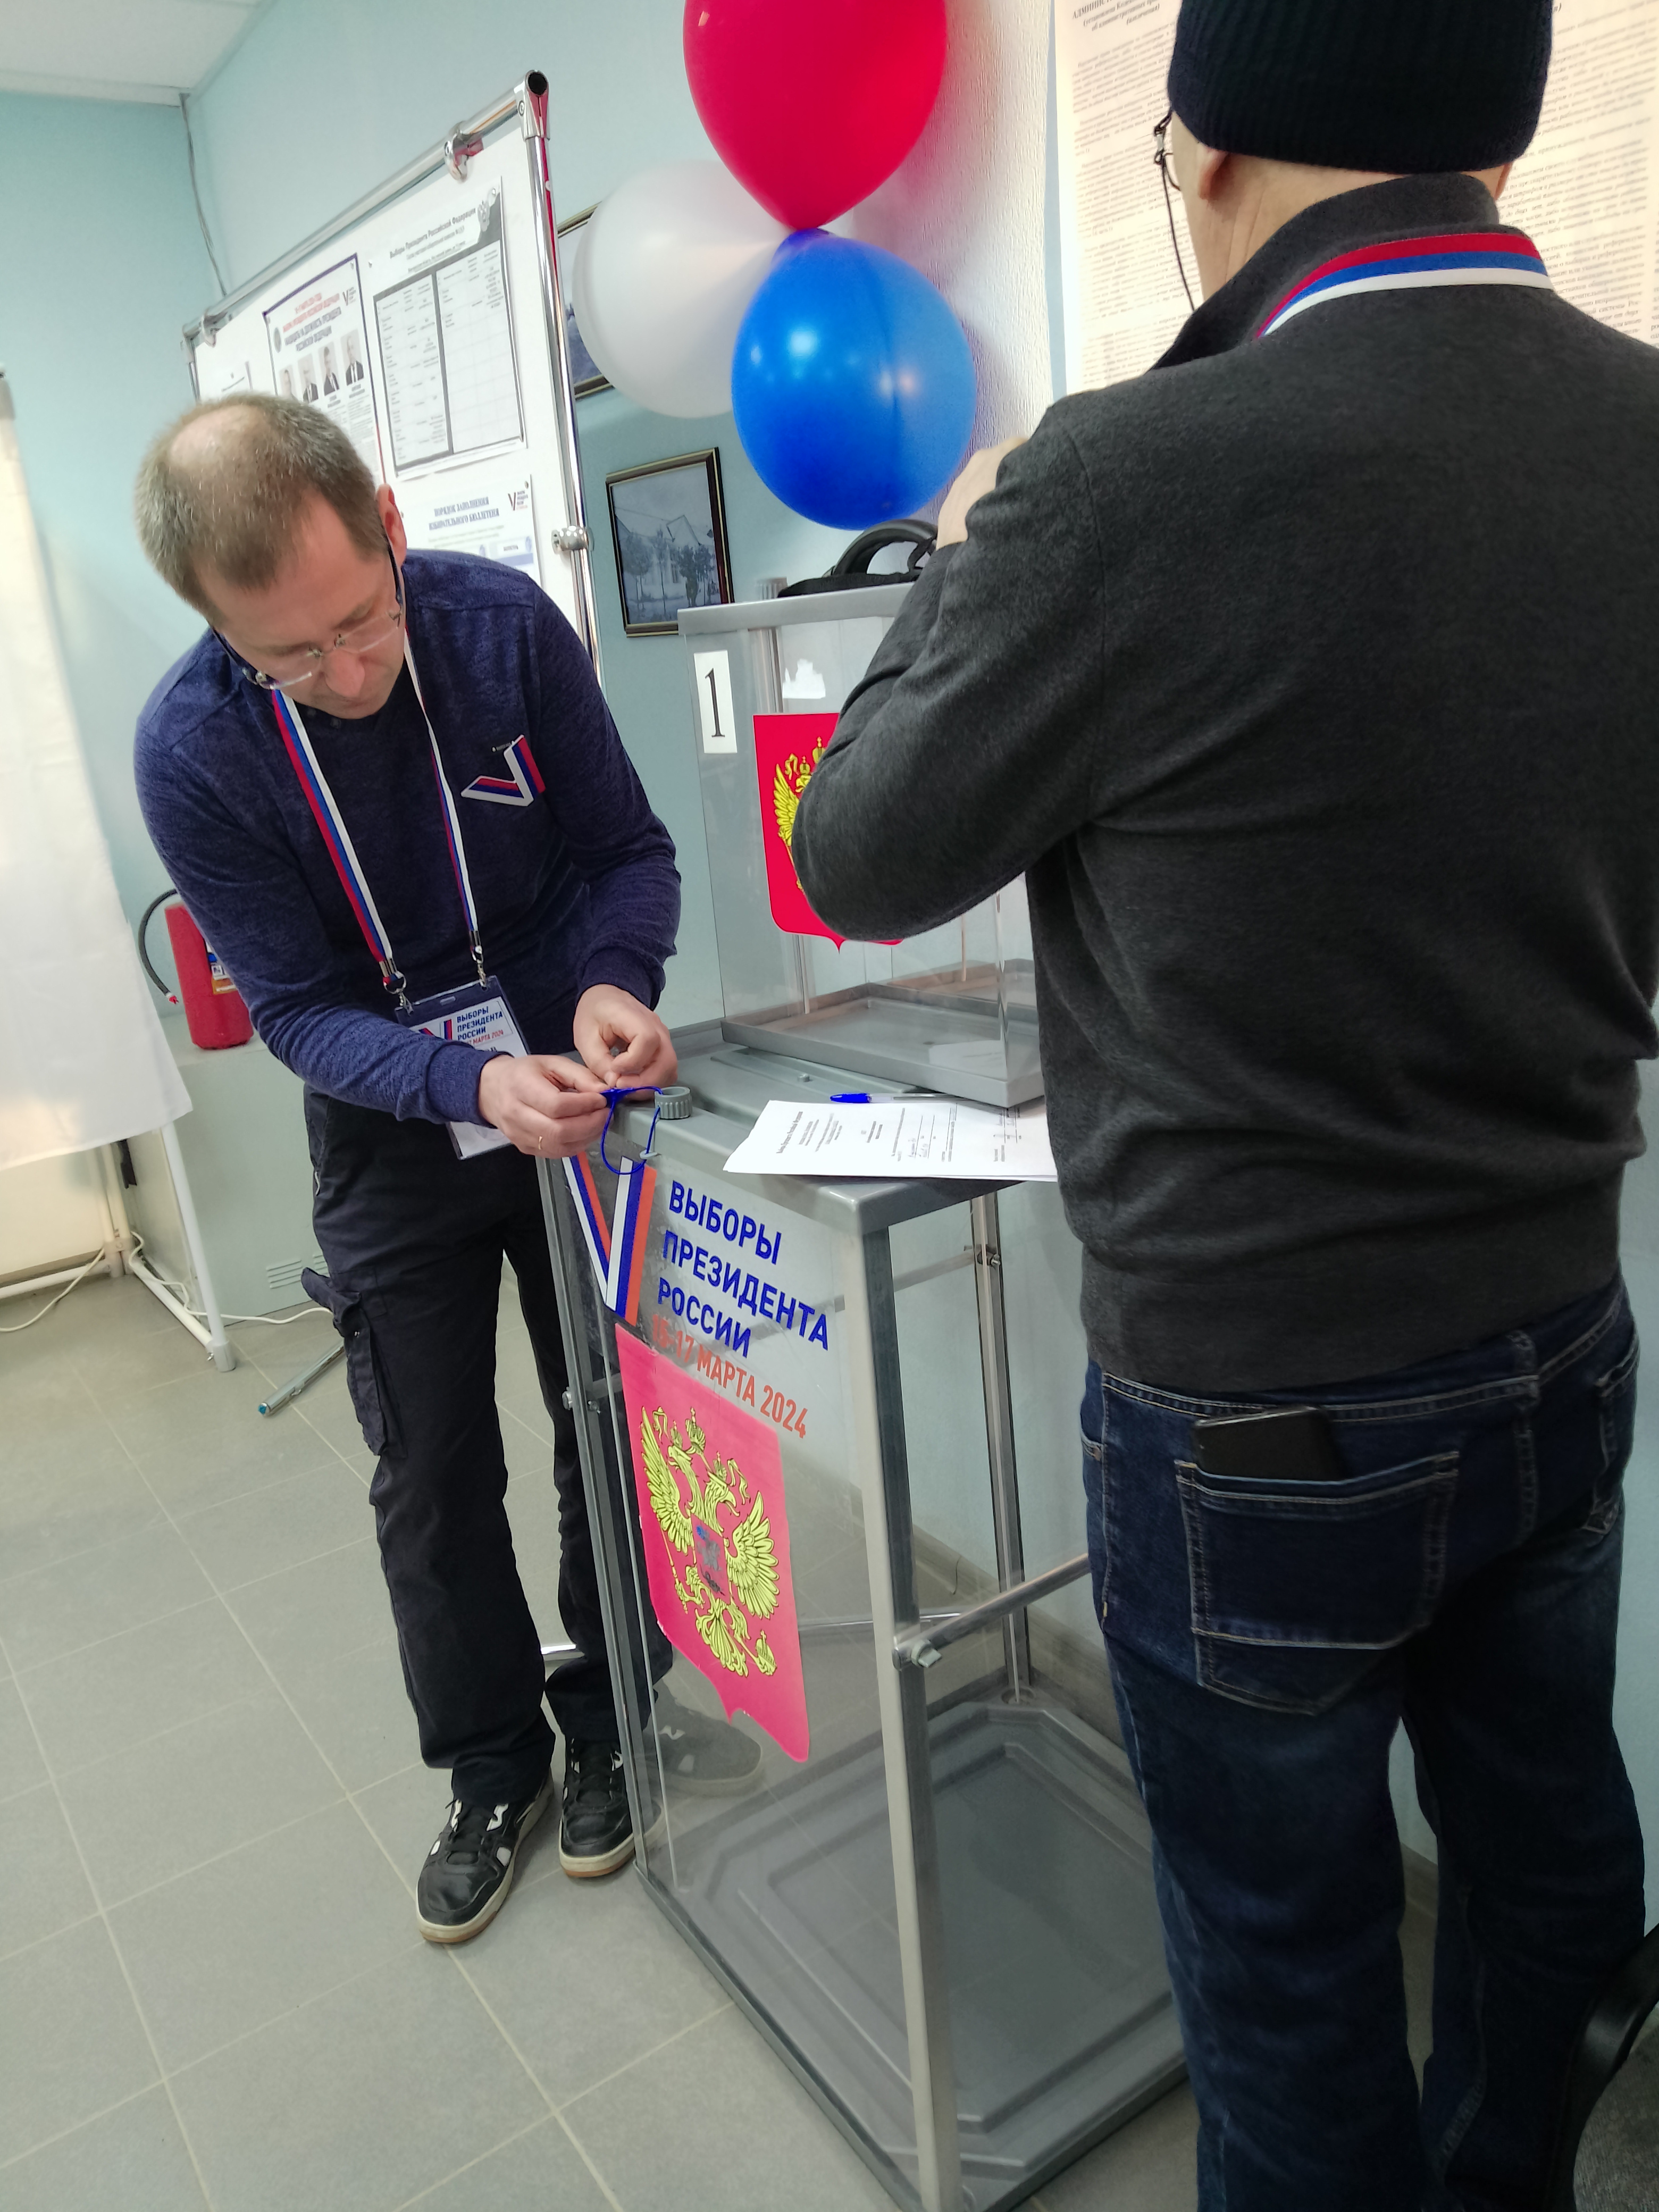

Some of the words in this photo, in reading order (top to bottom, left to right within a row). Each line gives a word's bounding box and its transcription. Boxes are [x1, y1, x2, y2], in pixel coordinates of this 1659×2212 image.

[705, 667, 725, 738] 1
[457, 1006, 489, 1023] ВЫБОРЫ
[457, 1011, 503, 1033] ПРЕЗИДЕНТА
[457, 1026, 486, 1041] РОССИИ
[473, 1035, 491, 1045] МАРТА
[491, 1029, 504, 1040] 2024
[669, 1179, 782, 1265] ВЫБОРЫ
[658, 1277, 751, 1358] РОССИИ
[663, 1229, 828, 1351] ПРЕЗИДЕНТА
[697, 1343, 755, 1408] МАРТА
[760, 1384, 808, 1439] 2024
